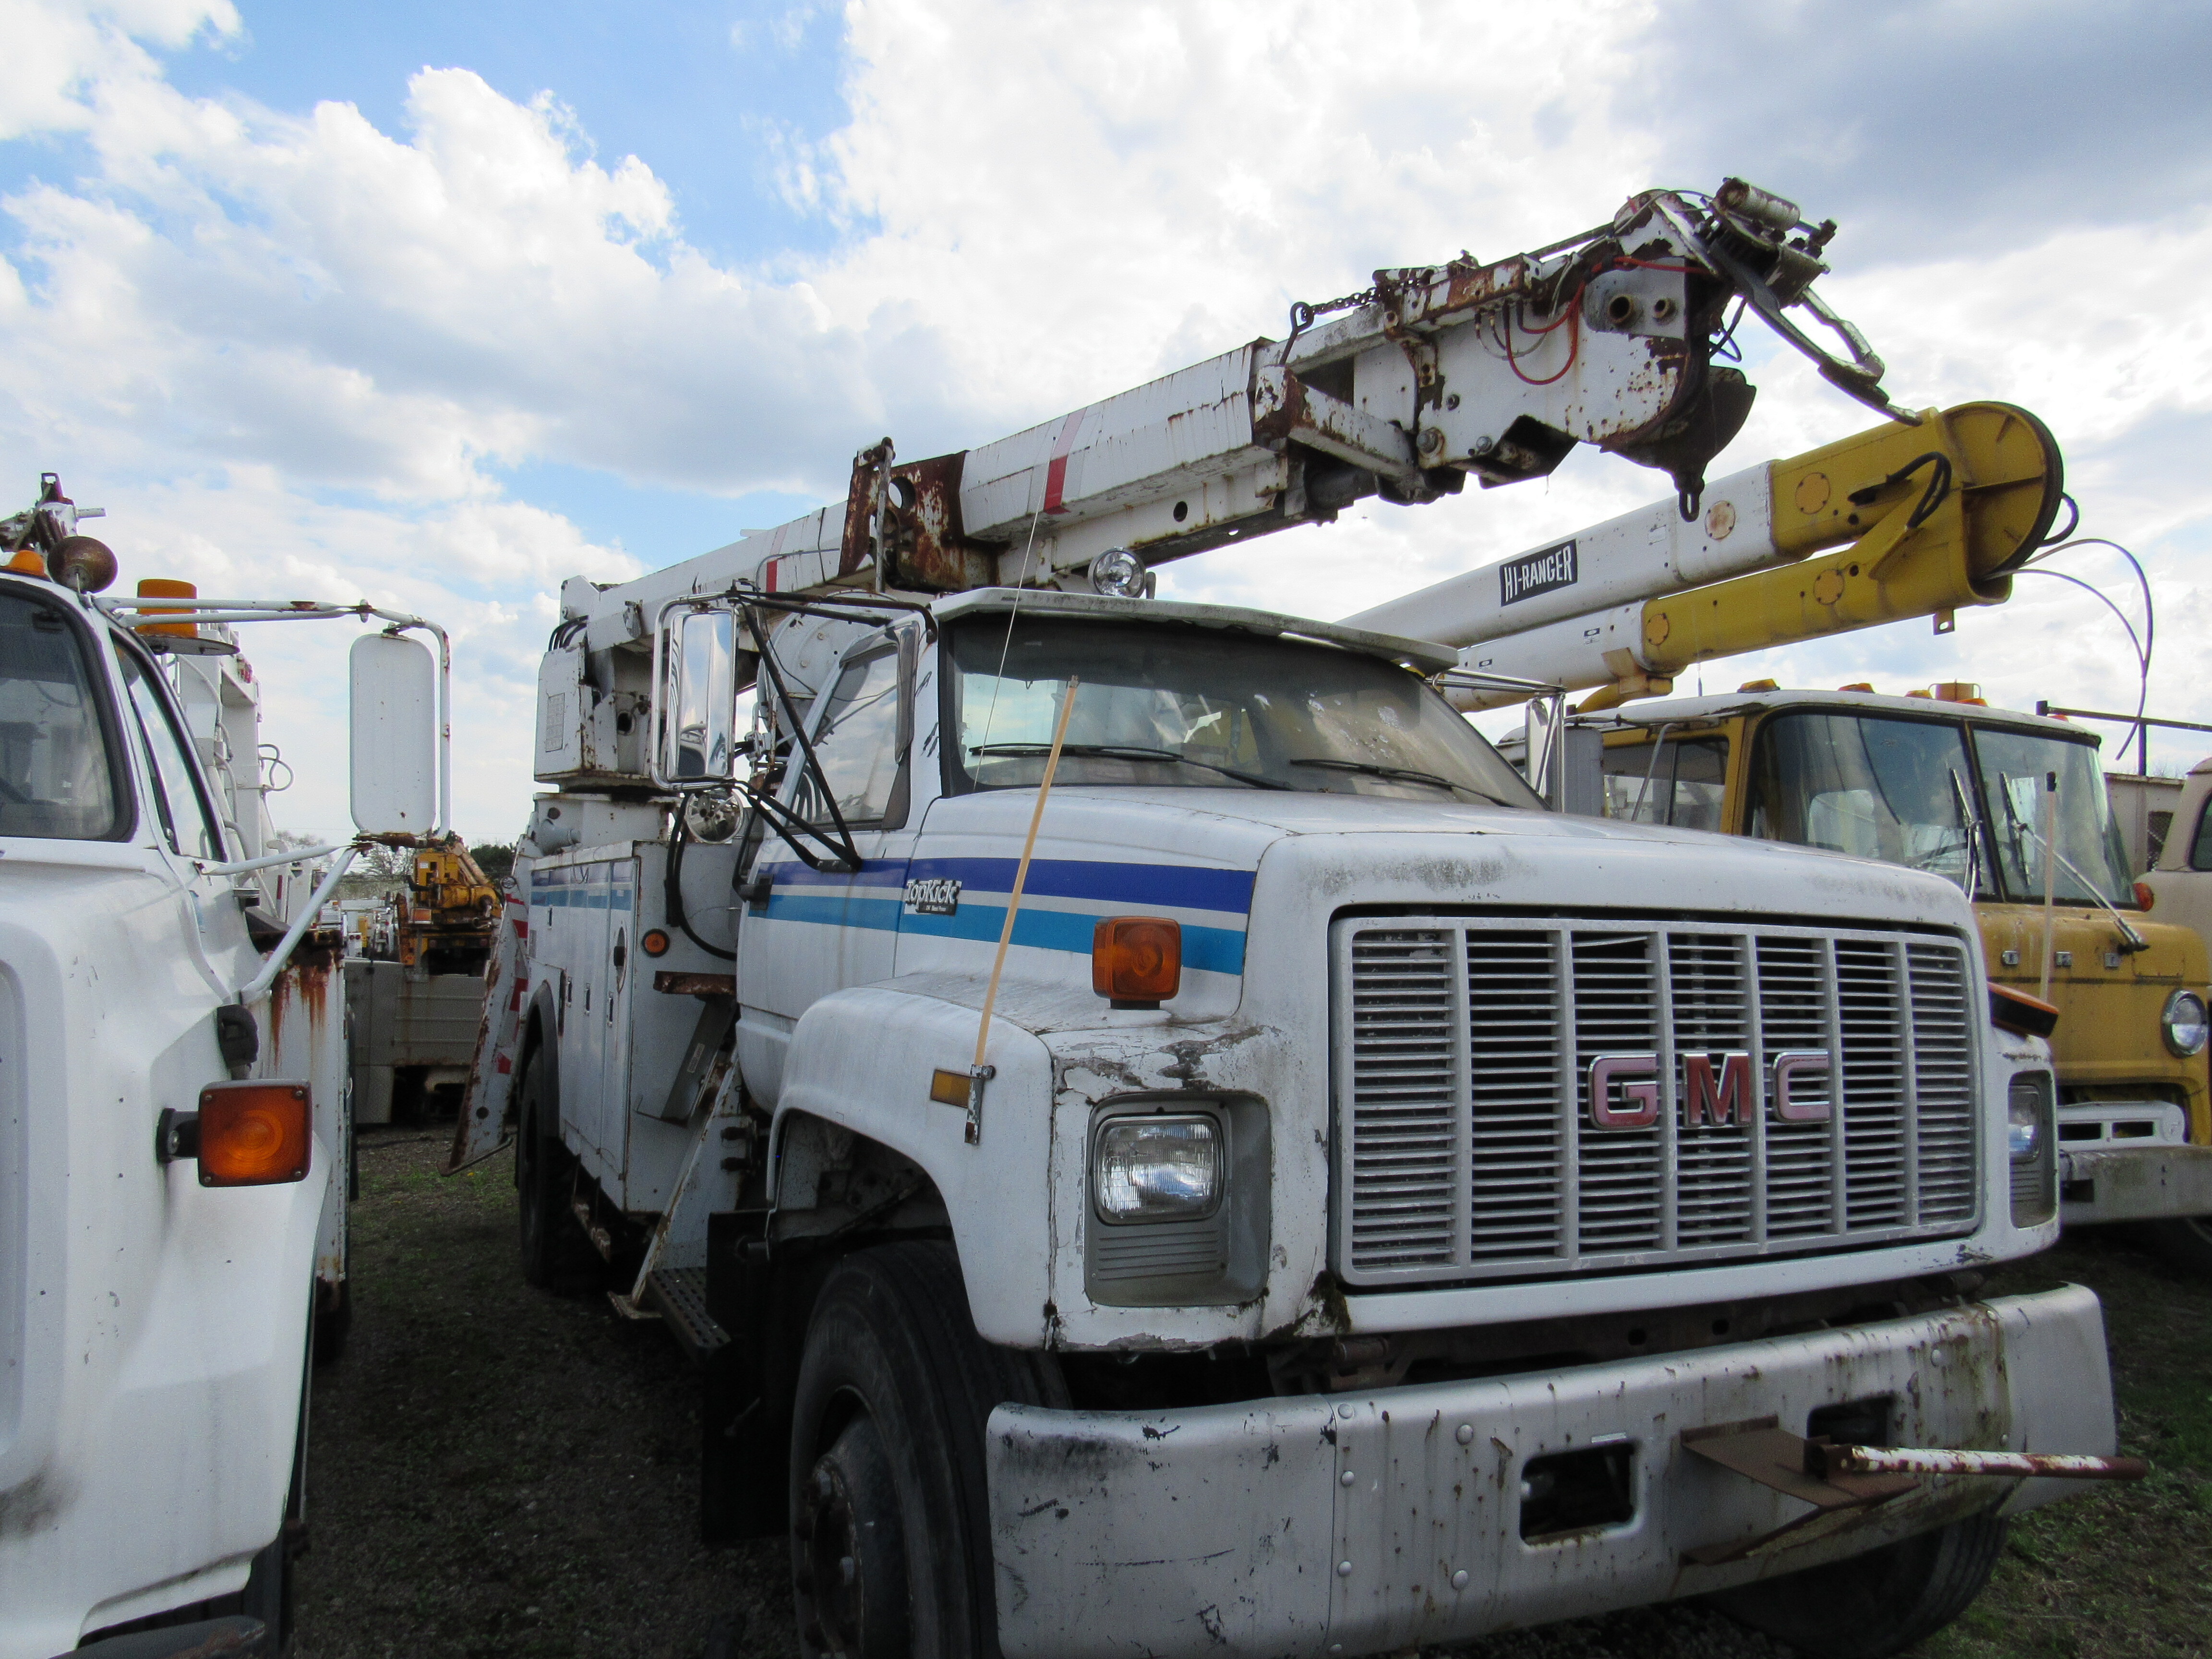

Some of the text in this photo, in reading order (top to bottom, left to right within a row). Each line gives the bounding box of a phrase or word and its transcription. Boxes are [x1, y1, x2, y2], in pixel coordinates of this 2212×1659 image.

[1503, 545, 1572, 602] HI-RANGER
[905, 879, 957, 911] TopKick
[1588, 1051, 1830, 1130] GMC
